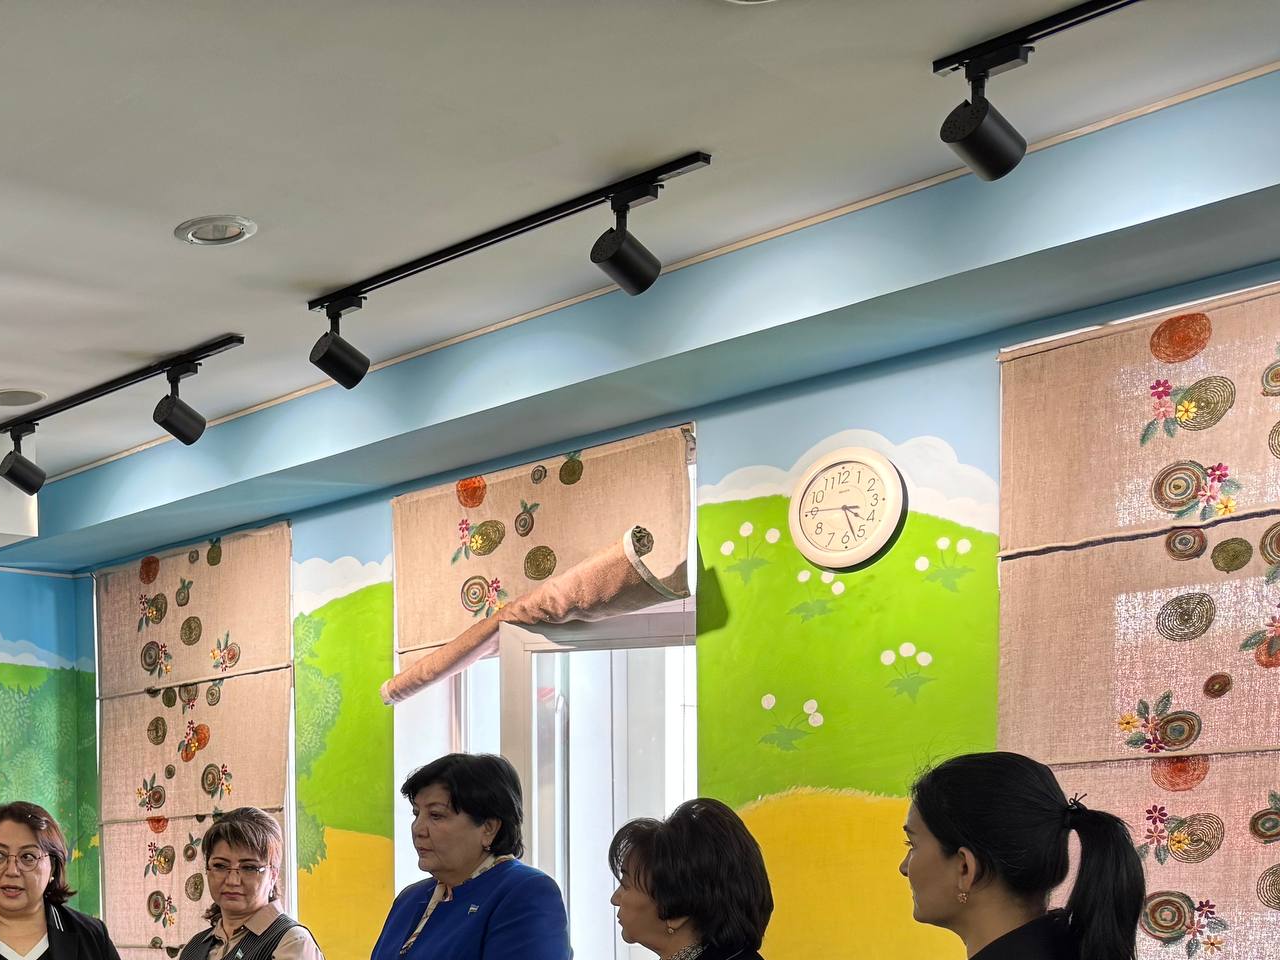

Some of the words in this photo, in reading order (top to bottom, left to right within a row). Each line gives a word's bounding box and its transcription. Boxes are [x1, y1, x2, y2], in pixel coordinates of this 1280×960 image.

[824, 476, 835, 490] 11
[837, 470, 851, 485] 12
[867, 478, 876, 492] 2
[811, 489, 824, 504] 10
[871, 493, 879, 507] 3
[810, 507, 819, 520] 9
[866, 509, 875, 522] 4
[815, 522, 823, 535] 8
[856, 524, 866, 538] 5
[827, 532, 835, 546] 7
[841, 531, 850, 545] 6
